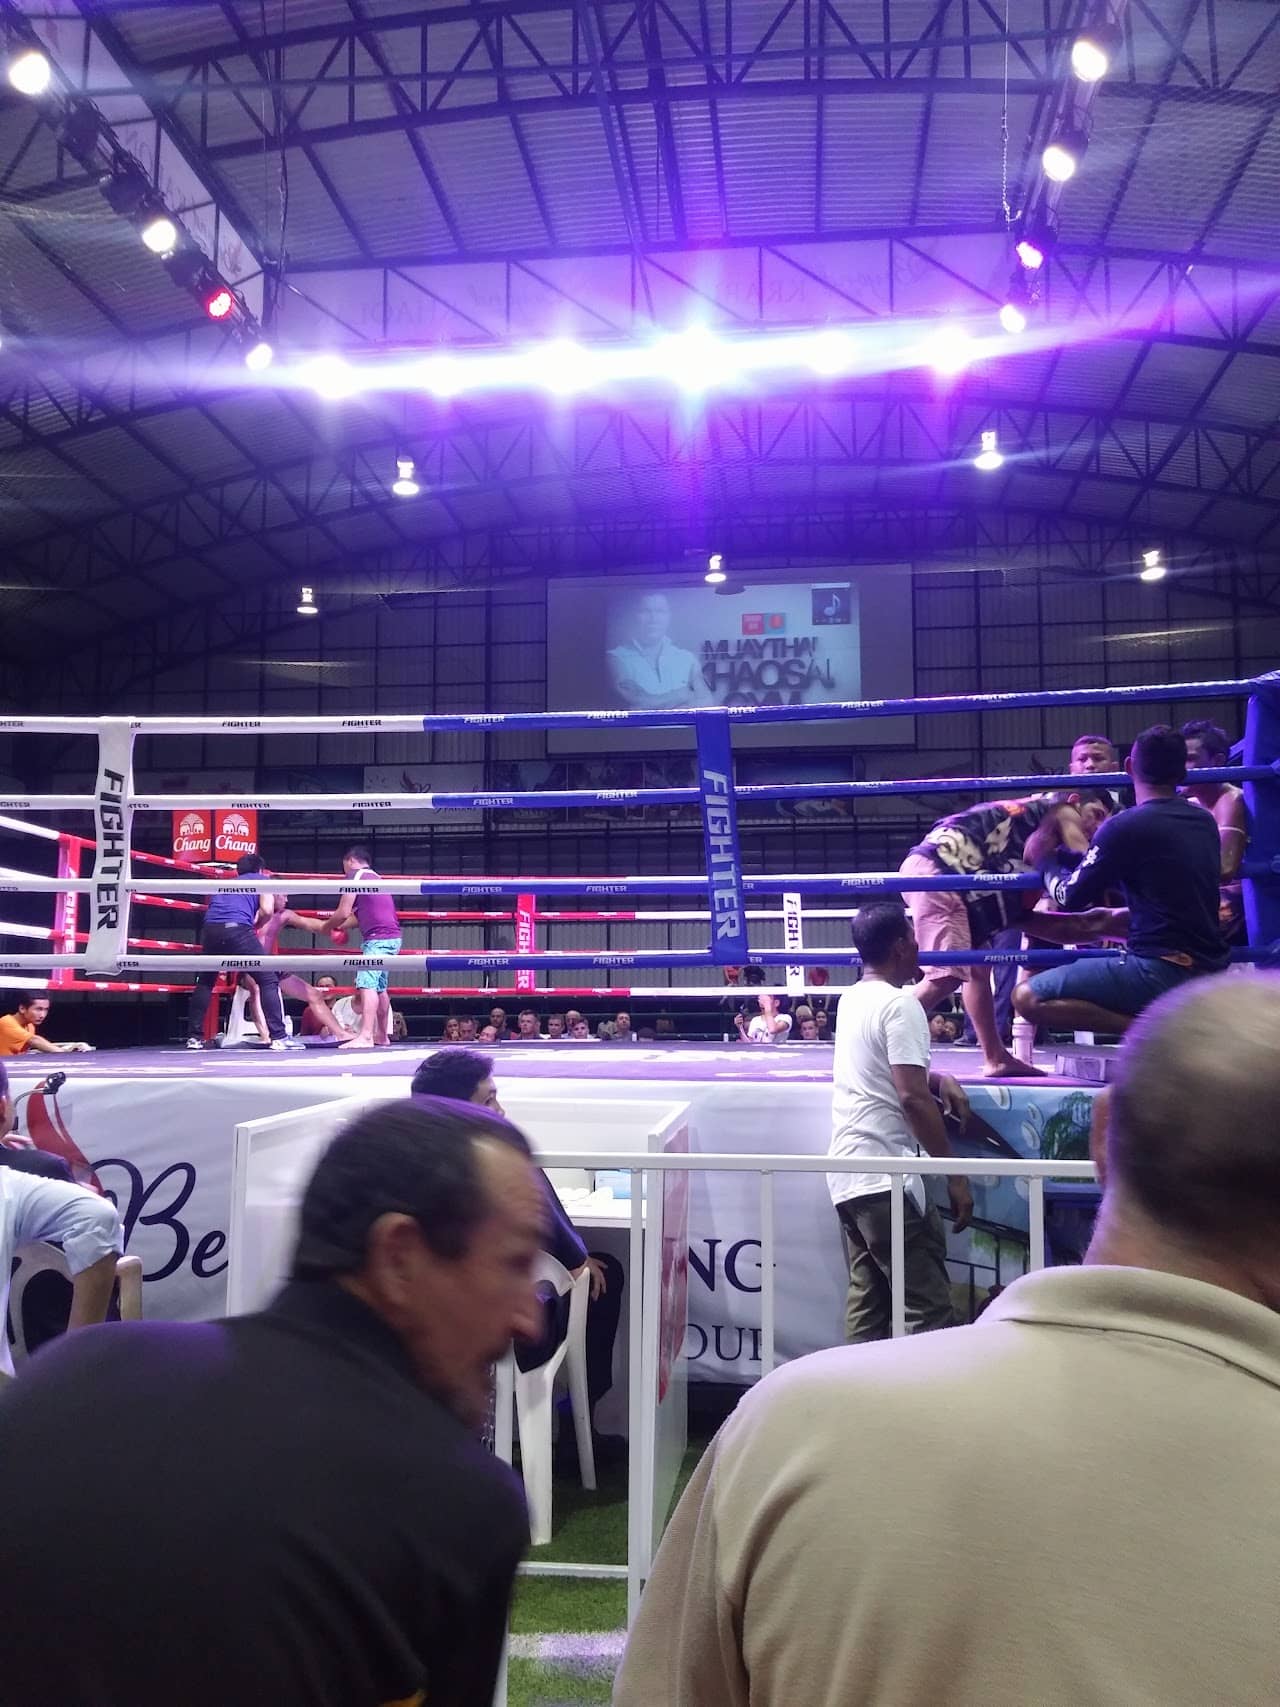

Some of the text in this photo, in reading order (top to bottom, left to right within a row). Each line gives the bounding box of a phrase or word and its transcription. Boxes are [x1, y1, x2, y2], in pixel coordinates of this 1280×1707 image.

[341, 719, 382, 727] FIGHTER
[463, 715, 505, 724] FIGHTER
[596, 791, 638, 800] FIGHTER
[473, 797, 514, 806] FIGHTER
[173, 837, 211, 852] Chang
[215, 834, 257, 854] Chang
[97, 768, 125, 930] FIGHTER
[703, 769, 741, 940] FIGHTER
[841, 878, 885, 886] FIGHTER
[972, 873, 1019, 882] FIGHTER
[586, 885, 627, 893] FIGHTER
[592, 957, 635, 965] FIGHTER
[983, 954, 1029, 962] FIGHTER
